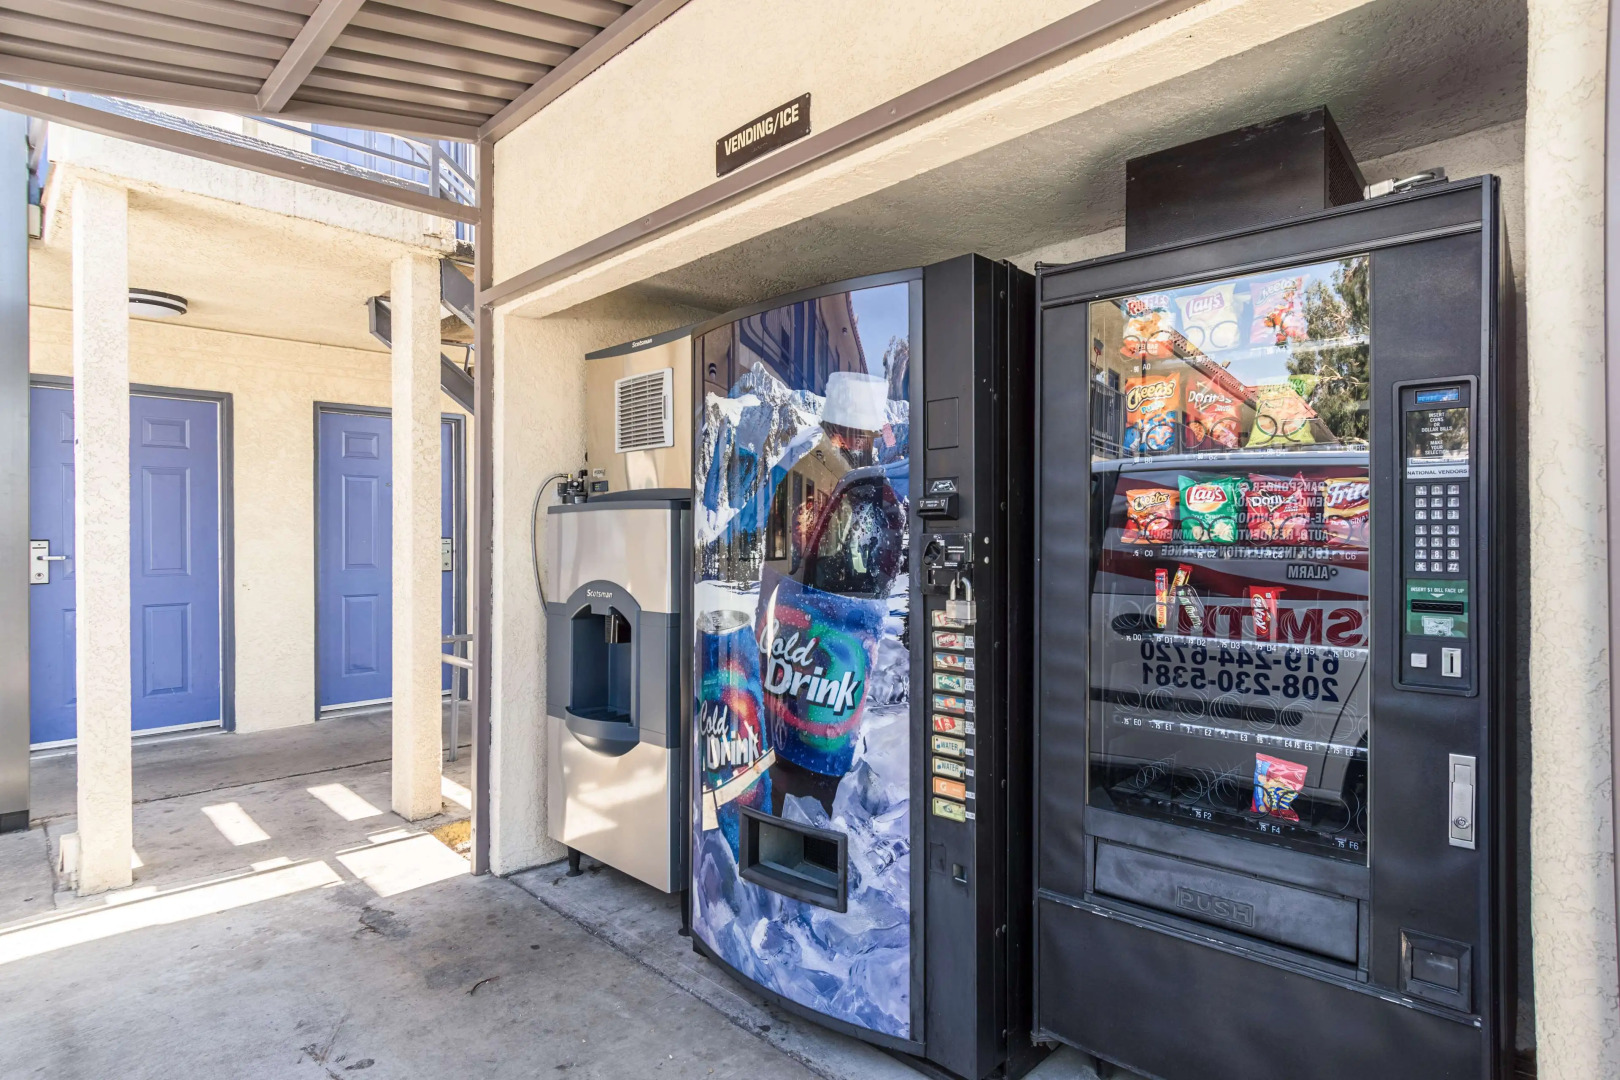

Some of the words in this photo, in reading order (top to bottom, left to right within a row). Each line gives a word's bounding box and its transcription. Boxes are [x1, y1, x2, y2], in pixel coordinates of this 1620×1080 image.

[724, 103, 799, 155] VENDING/ICE
[1126, 383, 1175, 411] Cheetos
[1190, 486, 1223, 504] Lay's
[1133, 492, 1170, 511] Cheetos
[1345, 552, 1356, 560] C6
[587, 589, 613, 598] Scotsman
[1133, 633, 1142, 641] D0
[1165, 636, 1173, 644] D1
[760, 619, 818, 667] Cold
[1197, 638, 1206, 646] D2
[1230, 641, 1240, 649] D3
[1267, 644, 1276, 652] D4
[1343, 650, 1355, 658] D6
[763, 658, 860, 715] Drink
[700, 700, 729, 736] Cold
[1165, 723, 1172, 731] E1
[1204, 728, 1212, 737] E2
[1240, 733, 1248, 742] E3
[706, 725, 760, 770] Drink
[941, 741, 958, 751] WATER
[1304, 743, 1313, 751] E5
[1345, 748, 1354, 757] E6
[941, 762, 959, 772] WATER
[1203, 811, 1212, 820] F2
[1271, 825, 1281, 834] F4
[1349, 840, 1359, 850] F6
[1181, 891, 1249, 923] PUSH
